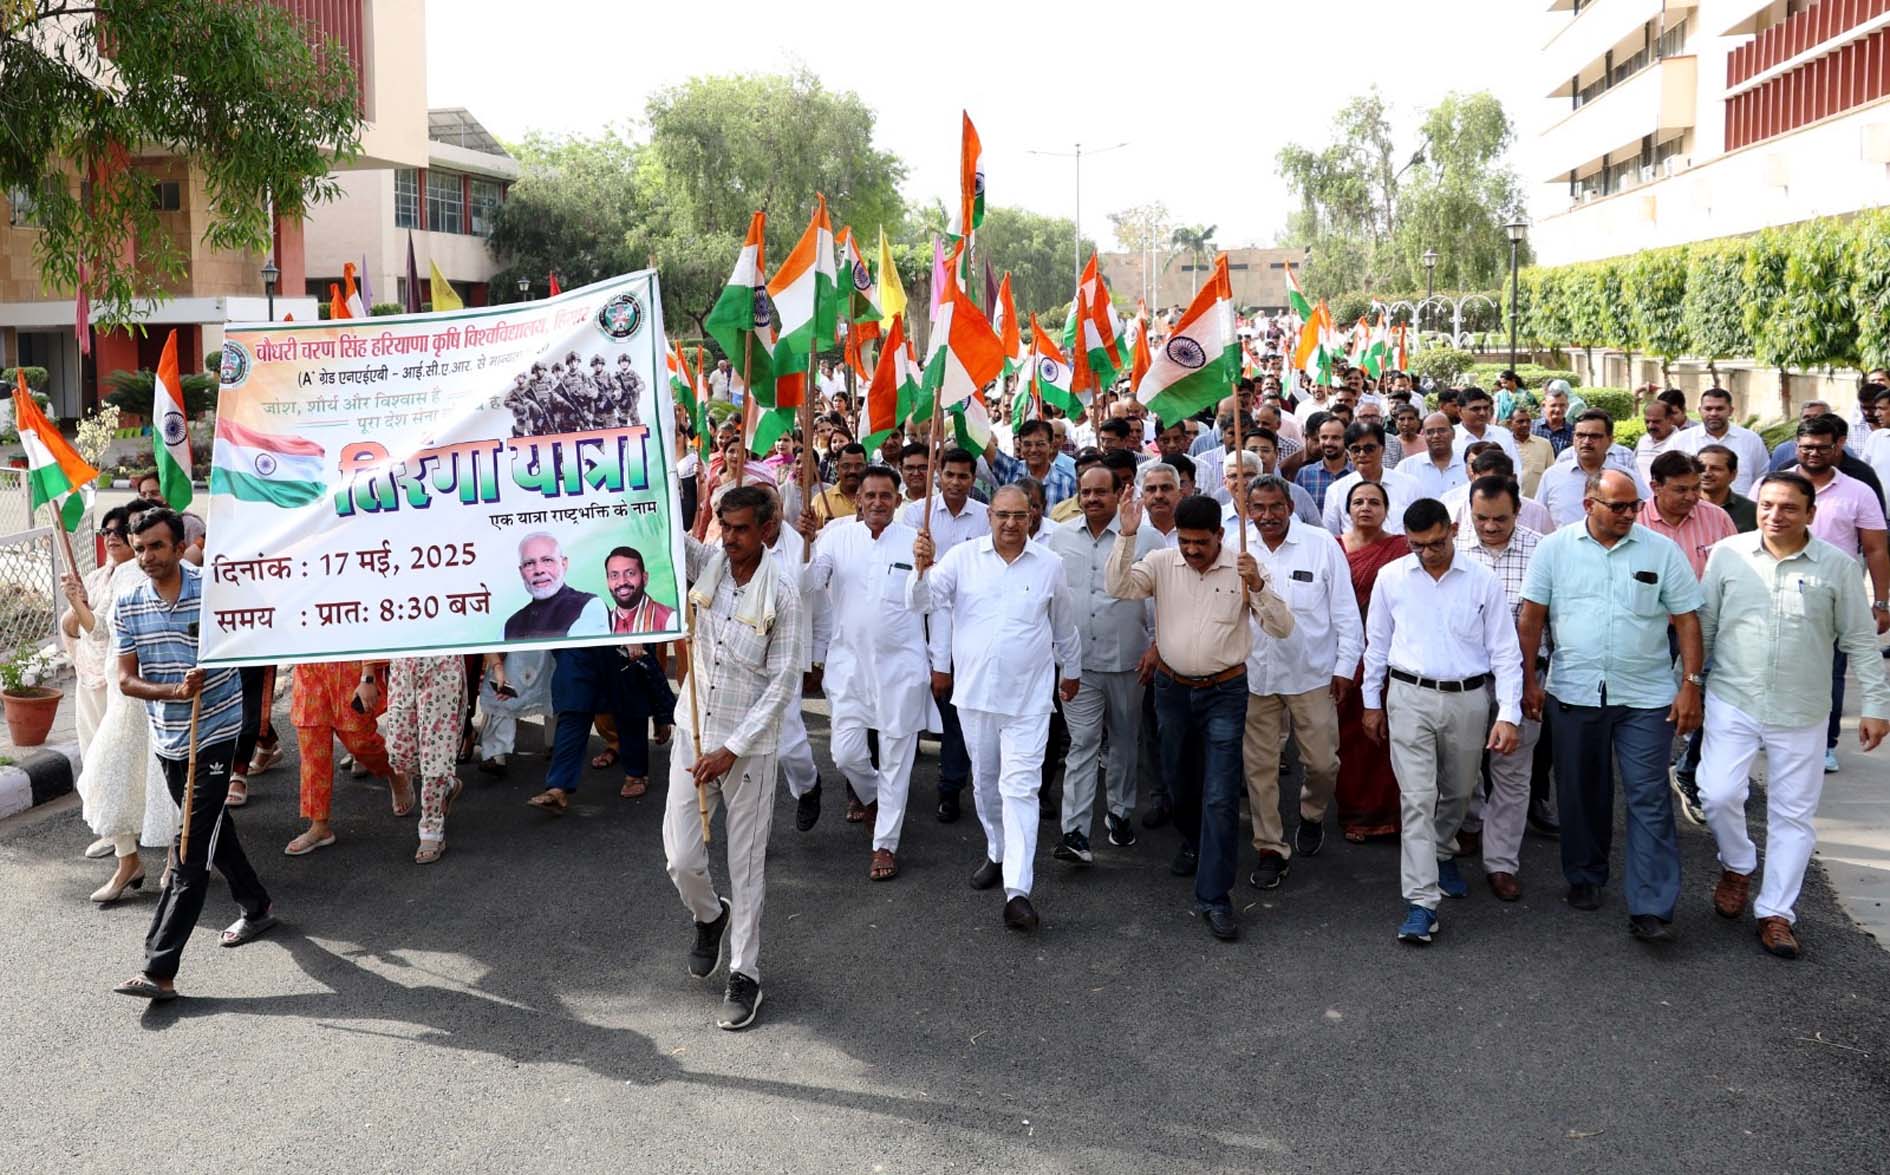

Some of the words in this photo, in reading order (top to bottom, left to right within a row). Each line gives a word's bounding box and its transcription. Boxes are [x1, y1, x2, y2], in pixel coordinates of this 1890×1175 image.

[256, 337, 297, 362] चौधरी
[302, 341, 336, 360] चरण
[339, 334, 368, 358] सिंह
[371, 332, 428, 356] हरियाणा
[432, 327, 461, 357] कृषि
[319, 368, 336, 385] ग्रेड
[307, 395, 339, 413] शौर्य
[343, 393, 371, 410] और
[374, 391, 428, 409] विश्वास
[357, 416, 382, 434] पूरा
[384, 410, 408, 428] देश
[507, 424, 650, 498] यात्रा
[489, 514, 514, 530] एक
[517, 511, 548, 525] यात्रा
[551, 503, 609, 525] राष्ट्रभक्ति
[610, 500, 628, 517] के
[630, 501, 657, 515] नाम
[211, 552, 292, 586] दिनांक
[320, 552, 349, 576] 17
[356, 539, 400, 578] मई,
[410, 542, 476, 570] 2025
[214, 607, 276, 633] समय
[379, 595, 439, 622] 8:30
[446, 582, 491, 615] बजे
